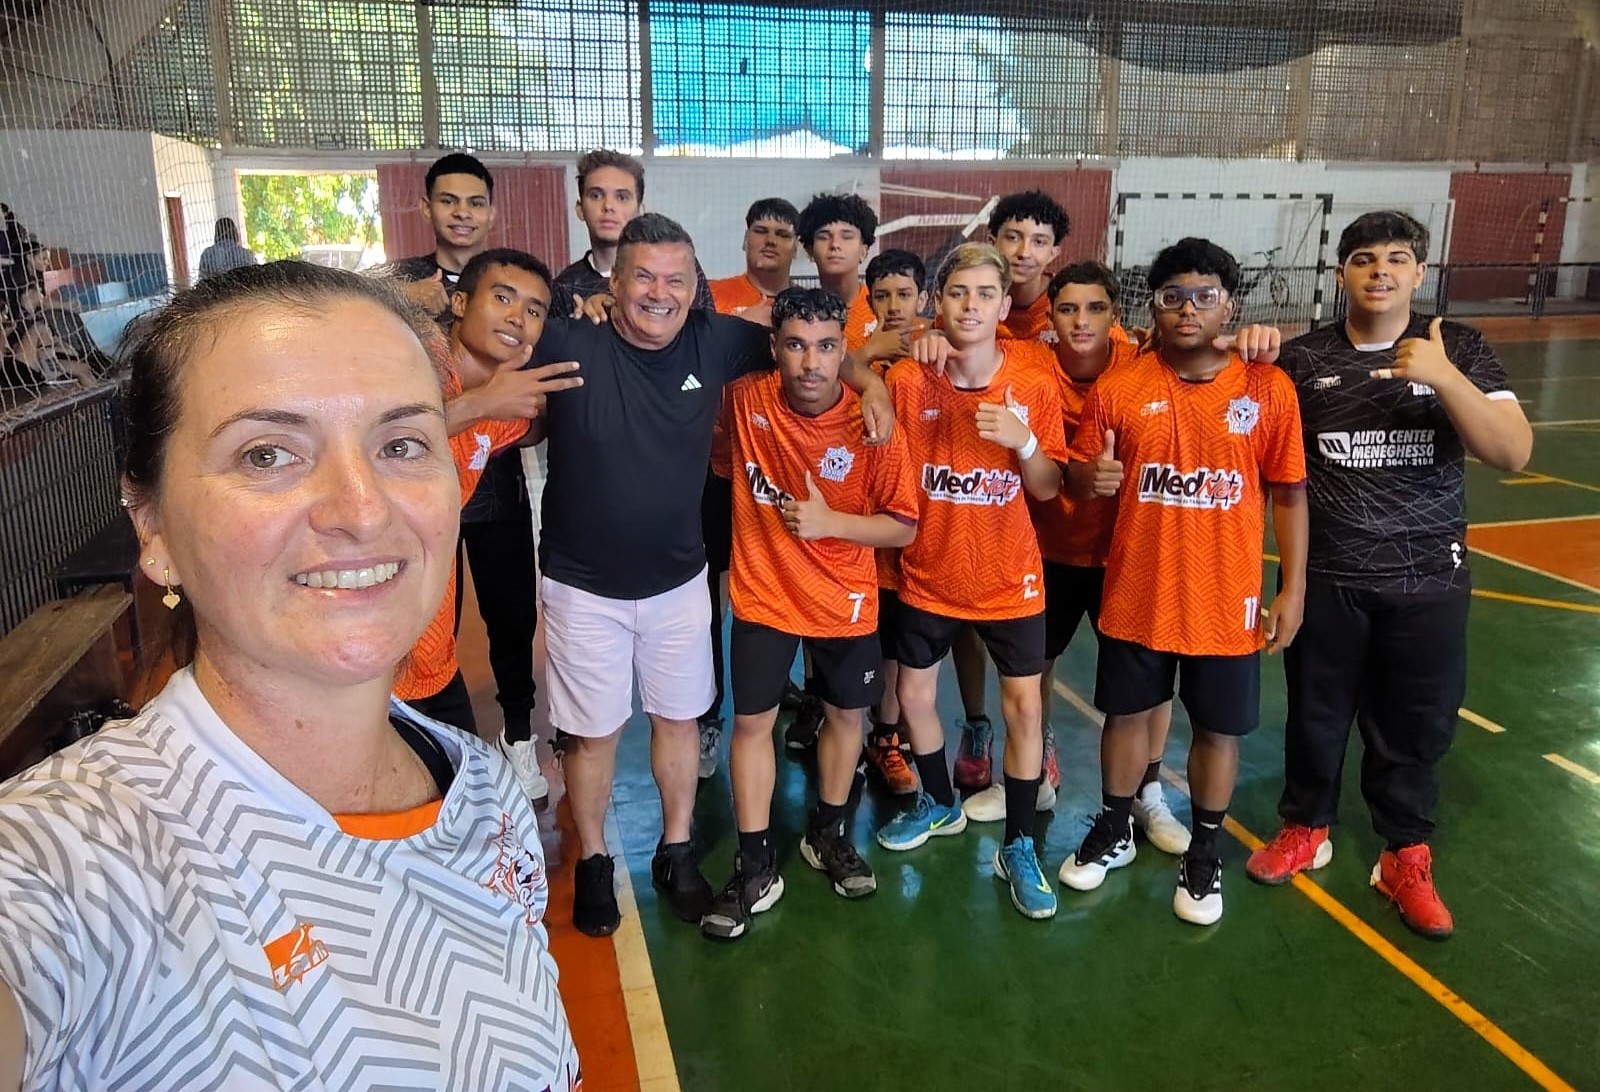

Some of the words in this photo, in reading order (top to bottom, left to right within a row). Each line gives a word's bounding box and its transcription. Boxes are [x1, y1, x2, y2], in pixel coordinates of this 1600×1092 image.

[1352, 431, 1386, 445] AUTO
[1389, 429, 1435, 443] CENTER
[1352, 443, 1434, 459] MENEGHESSO
[1022, 573, 1039, 600] 2
[848, 592, 865, 624] 7
[1243, 595, 1258, 631] 11
